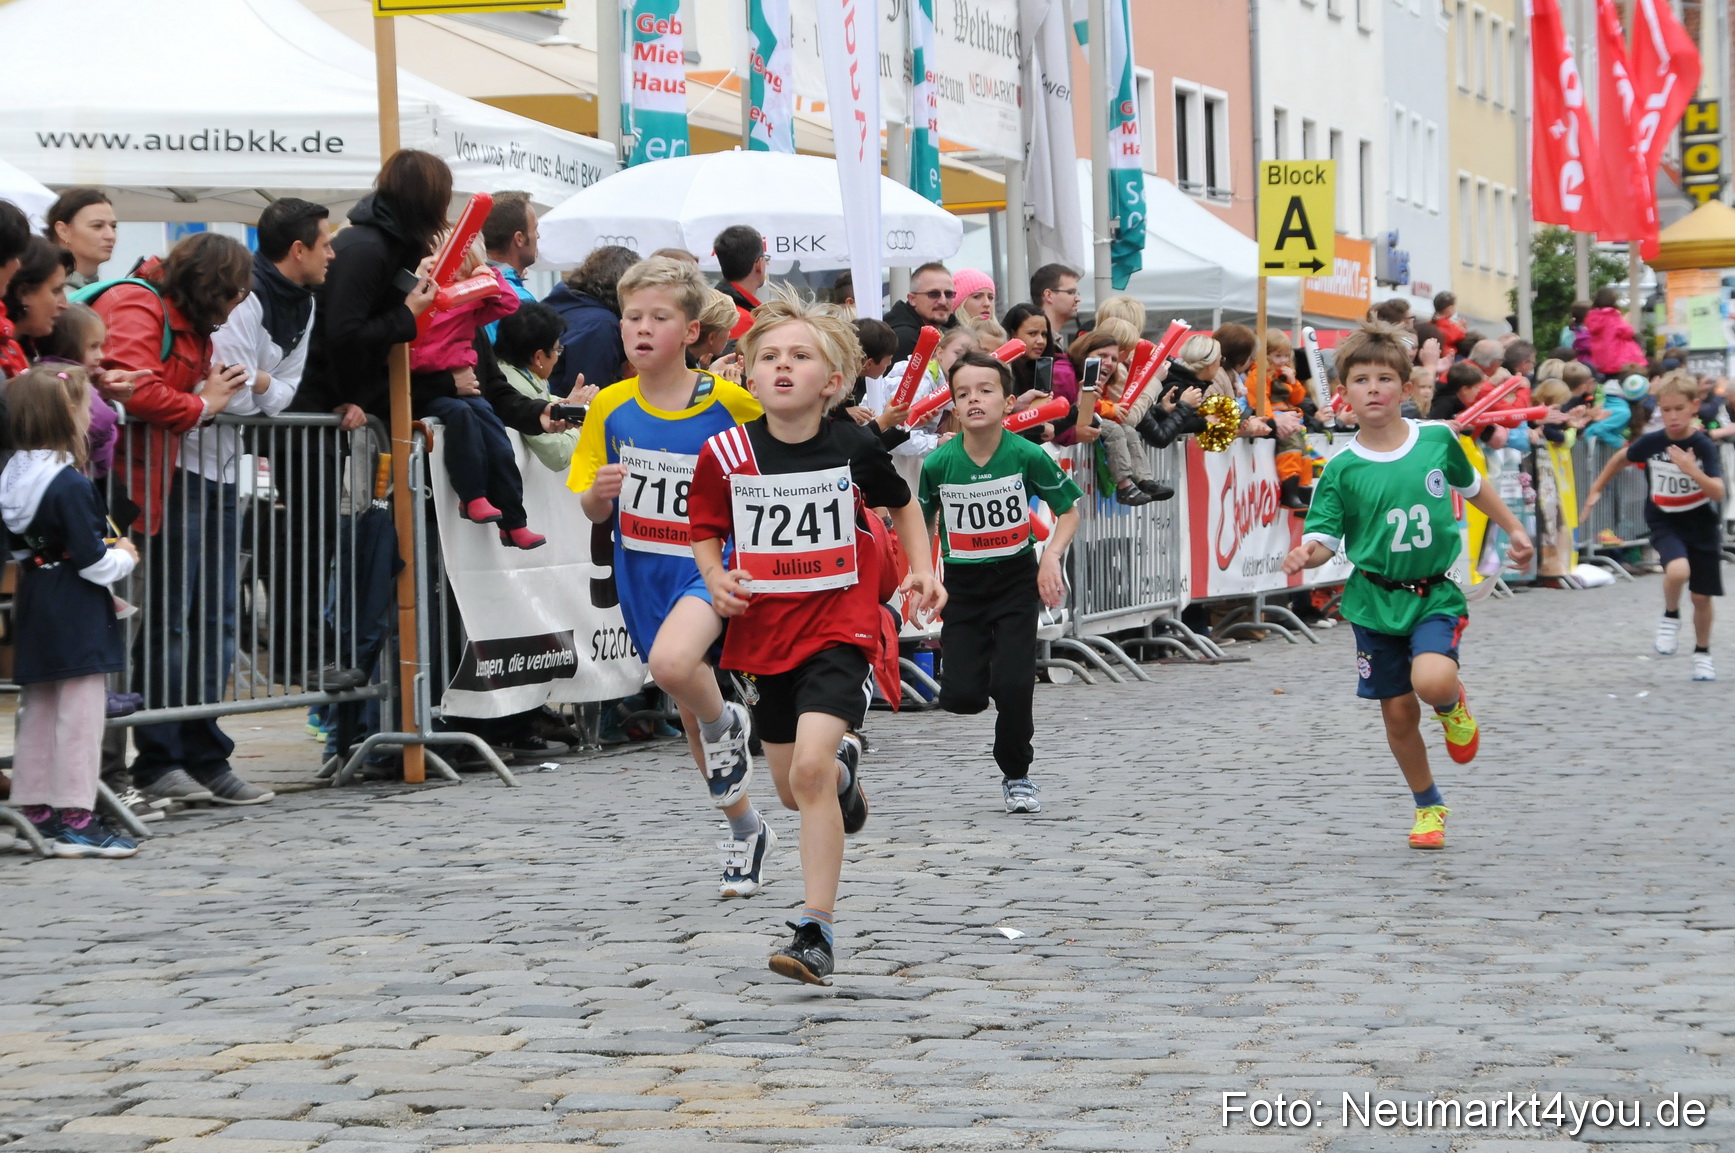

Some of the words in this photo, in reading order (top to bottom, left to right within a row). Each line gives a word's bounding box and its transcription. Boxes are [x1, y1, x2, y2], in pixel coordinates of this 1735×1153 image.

[968, 71, 1016, 105] NEUMARKT
[35, 128, 345, 154] www.audibkk.de
[454, 131, 480, 162] Von
[480, 143, 505, 171] uns,
[509, 140, 527, 170] für
[528, 152, 552, 178] uns:
[555, 154, 580, 186] Audi
[1268, 164, 1327, 185] Block
[1274, 195, 1318, 251] A
[776, 235, 827, 253] BKK
[621, 455, 655, 471] PARTL
[734, 486, 770, 498] PARTL
[773, 483, 833, 498] Neumarkt
[941, 490, 969, 500] PARTL
[969, 486, 1012, 499] Neumarkt
[745, 498, 842, 547] 7241
[949, 495, 1022, 530] 7088
[1386, 503, 1433, 553] 23
[972, 535, 1008, 548] Marco
[772, 559, 822, 576] Julius
[507, 652, 526, 673] die
[526, 646, 575, 671] verbinden
